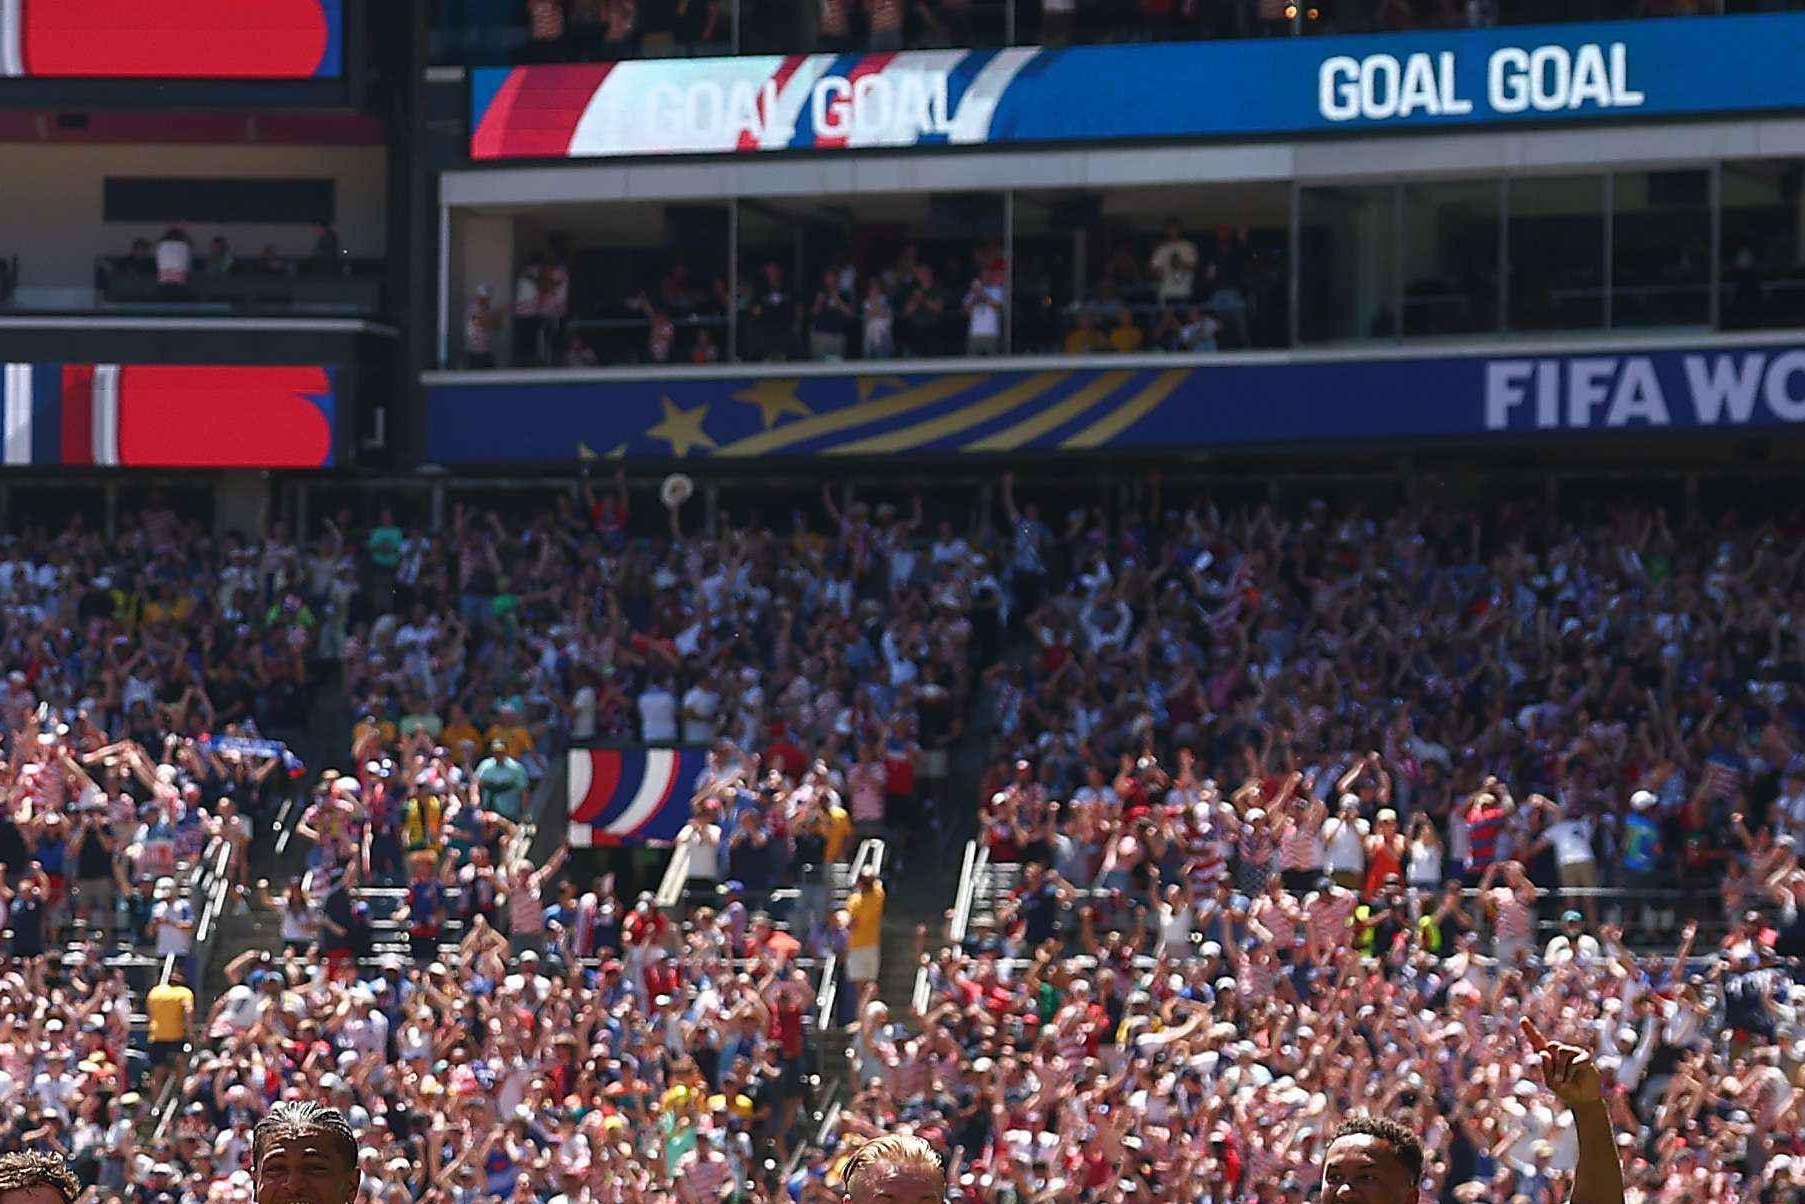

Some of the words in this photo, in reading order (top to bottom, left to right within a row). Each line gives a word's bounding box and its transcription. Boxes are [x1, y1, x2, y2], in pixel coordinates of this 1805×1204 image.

[646, 74, 793, 139] GOAL
[812, 69, 960, 137] GOAL
[1318, 50, 1473, 121] GOAL
[1487, 42, 1645, 113] GOAL
[1486, 357, 1671, 429] FIFA
